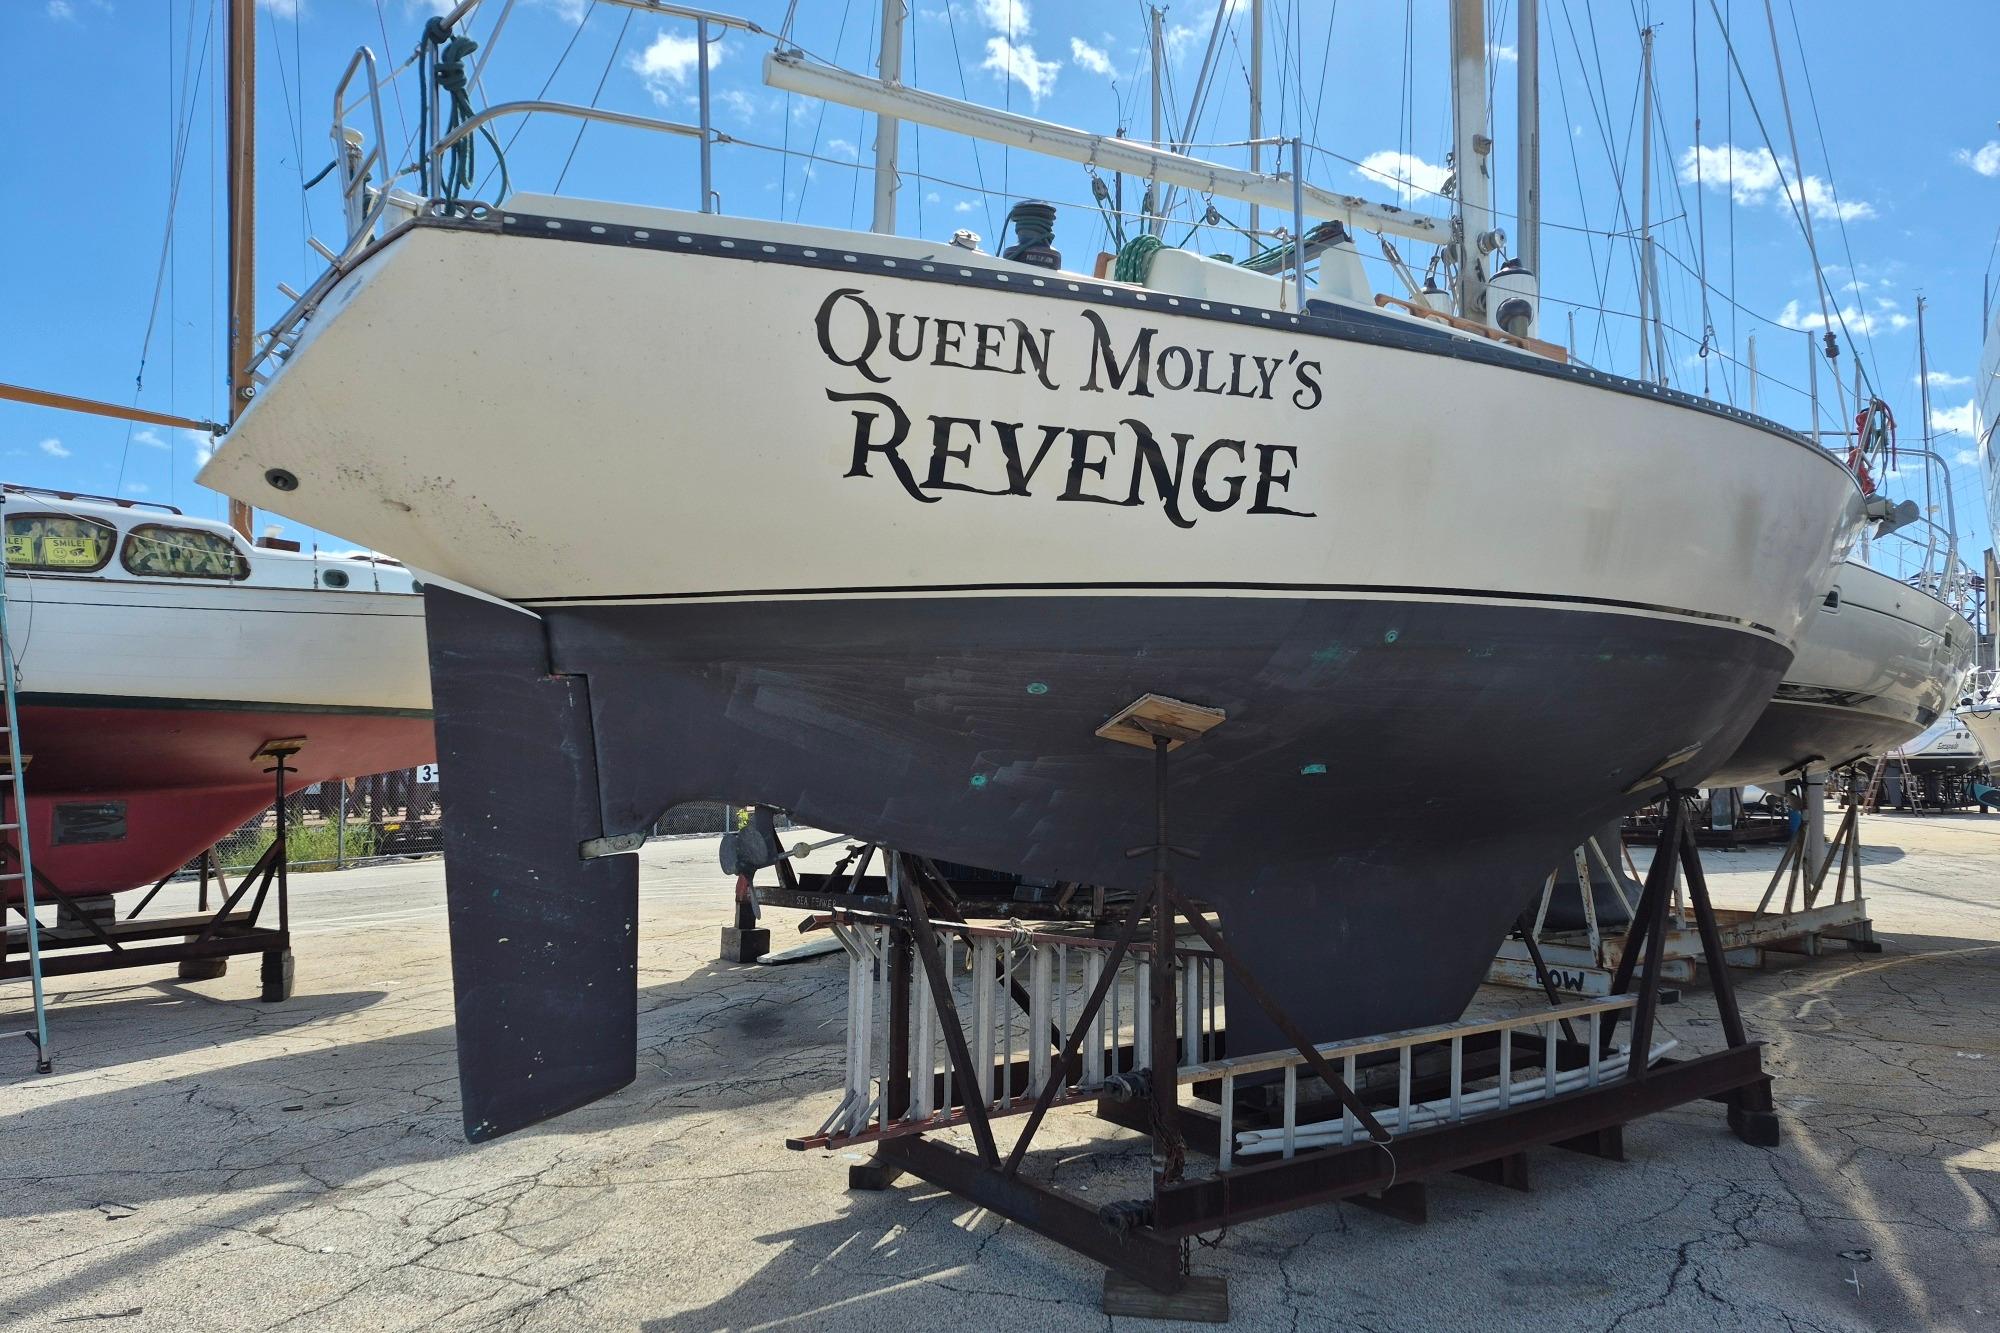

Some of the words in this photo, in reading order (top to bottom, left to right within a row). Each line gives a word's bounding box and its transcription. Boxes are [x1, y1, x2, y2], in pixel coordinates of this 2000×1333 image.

[815, 288, 1060, 390] QUEEN
[1080, 309, 1323, 410] MOLLY'S
[825, 387, 1318, 529] REVENGE
[53, 539, 85, 547] SMILE!
